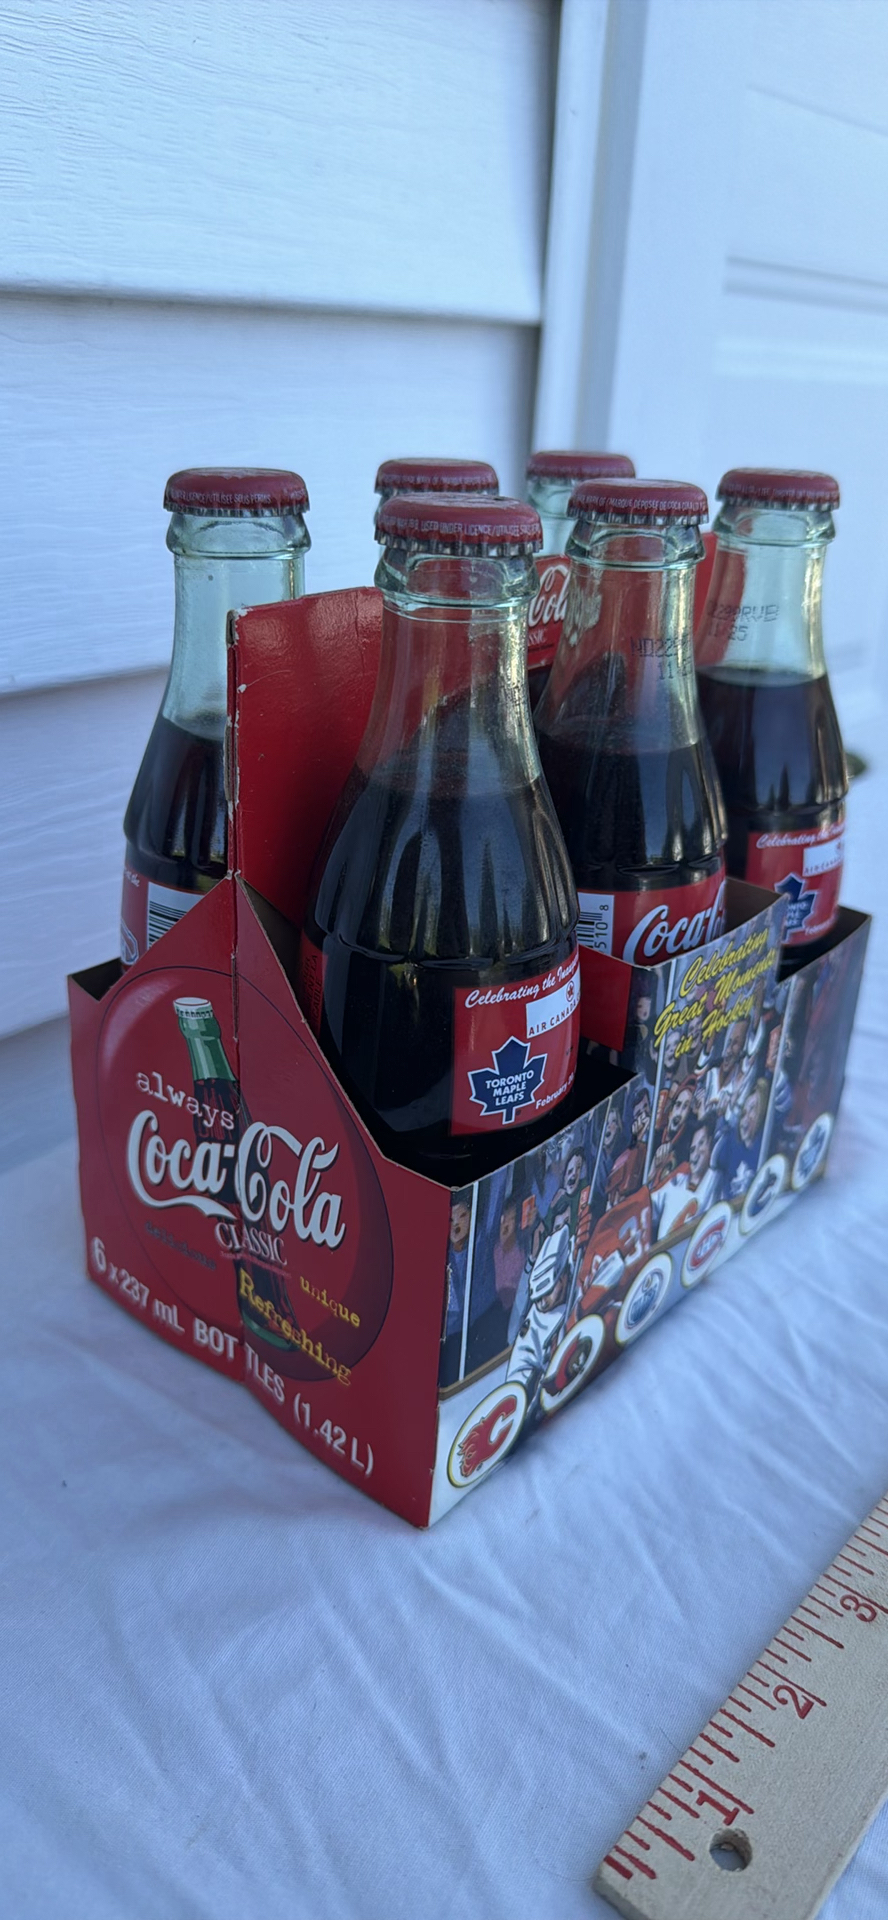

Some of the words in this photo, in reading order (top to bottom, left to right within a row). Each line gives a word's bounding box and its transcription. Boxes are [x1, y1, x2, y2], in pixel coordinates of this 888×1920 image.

[756, 833, 816, 849] Celebrating
[679, 928, 769, 998] Celebrating
[464, 984, 540, 1009] Celebrating
[542, 973, 556, 991] the
[654, 992, 708, 1048] Great
[713, 948, 777, 1005] Moments
[528, 1021, 547, 1036] AIR
[549, 999, 576, 1027] CANADA
[674, 1034, 693, 1059] in
[701, 994, 755, 1043] Hockey
[485, 1070, 535, 1089] TORONTO
[492, 1081, 527, 1097] MAPLE
[495, 1091, 525, 1106] LEAFS
[535, 1081, 567, 1110] February
[136, 1071, 235, 1130] always
[127, 1109, 346, 1249] Coca-Cola
[214, 1221, 288, 1266] CLASSIC
[91, 1236, 107, 1273] 6
[119, 1271, 150, 1308] 237
[153, 1299, 186, 1334] mL
[300, 1275, 361, 1328] unique
[238, 1268, 352, 1387] Refreshing
[840, 1594, 877, 1623] 3
[772, 1684, 815, 1720] 2
[695, 1789, 741, 1827] 1
